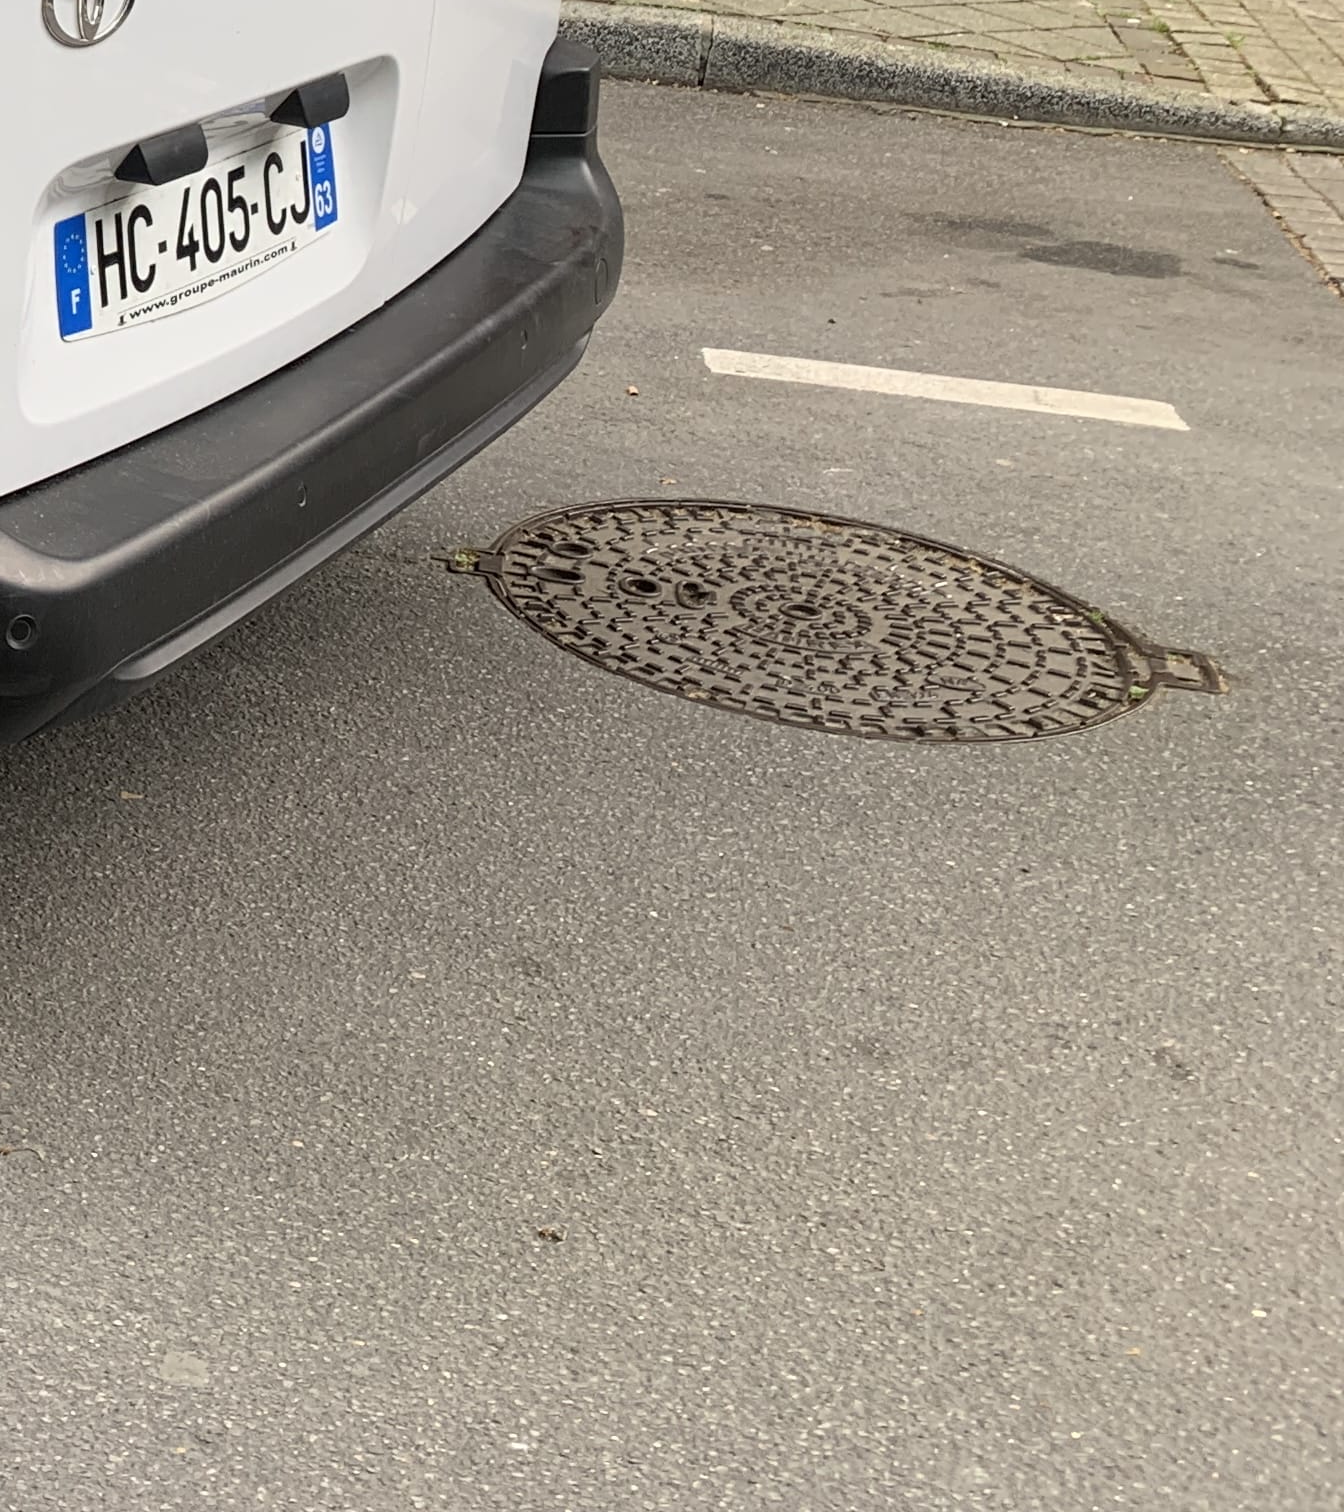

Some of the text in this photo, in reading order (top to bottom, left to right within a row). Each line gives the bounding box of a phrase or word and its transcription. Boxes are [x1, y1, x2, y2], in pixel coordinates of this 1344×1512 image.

[94, 141, 311, 309] HC-405-CJ
[315, 179, 333, 218] 63
[70, 288, 81, 316] F
[127, 246, 289, 322] www.groupe-maurin.com
